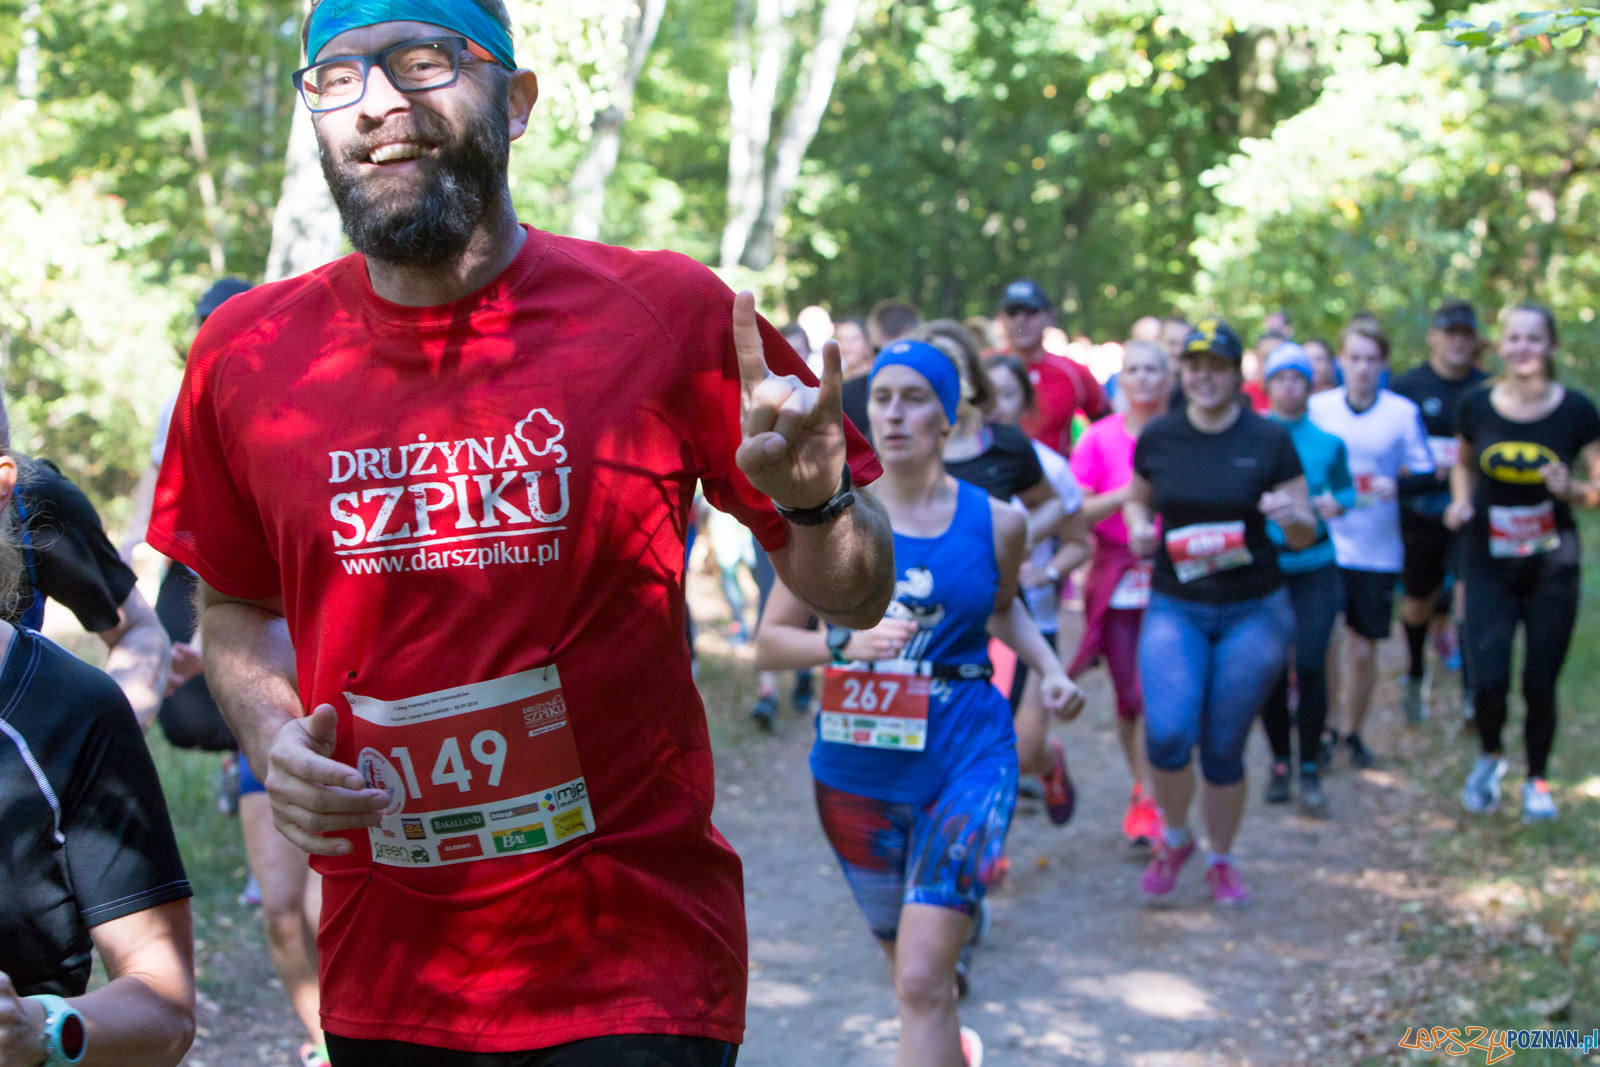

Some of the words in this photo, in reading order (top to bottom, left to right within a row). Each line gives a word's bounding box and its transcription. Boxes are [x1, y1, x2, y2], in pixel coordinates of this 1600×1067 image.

[328, 433, 528, 483] DRUŻYNA
[330, 466, 572, 547] SZPIKU
[341, 538, 560, 575] www.darszpiku.pl
[842, 678, 900, 712] 267
[390, 729, 508, 799] 149
[375, 842, 410, 858] green
